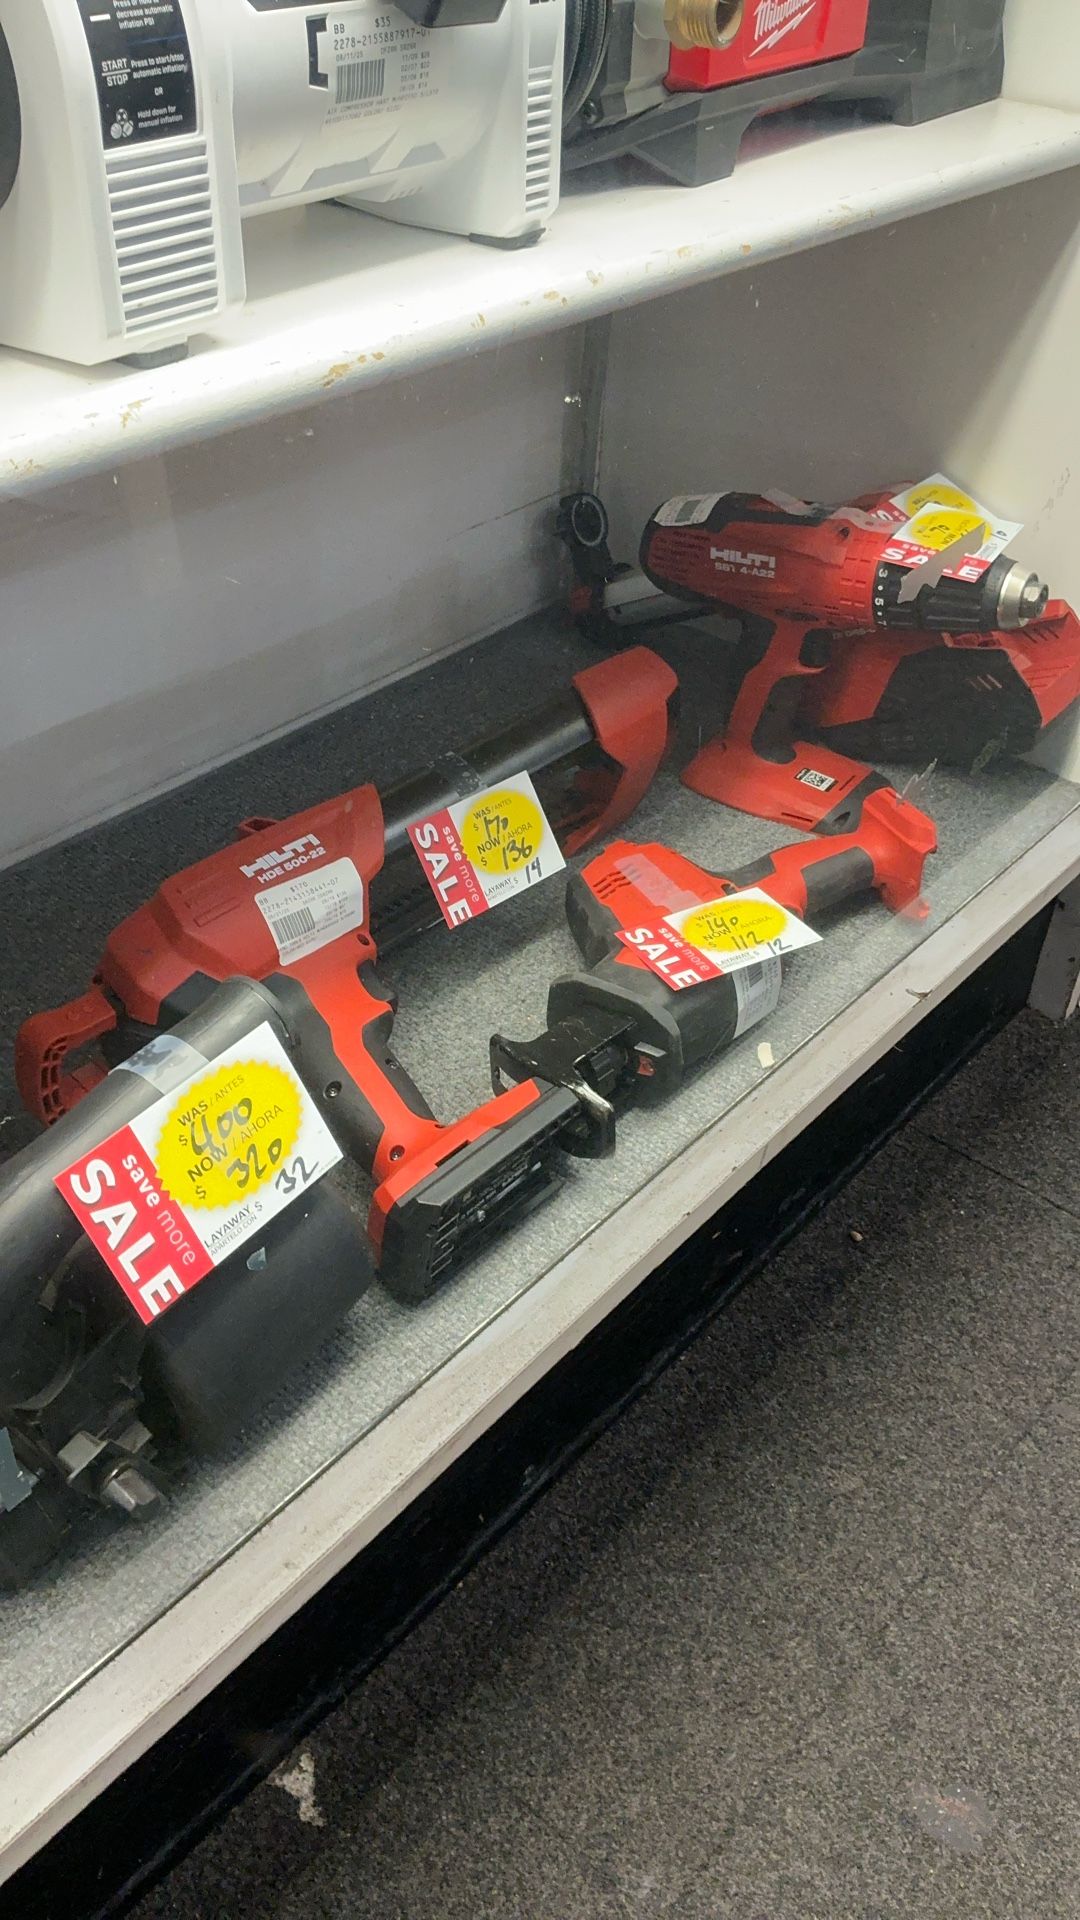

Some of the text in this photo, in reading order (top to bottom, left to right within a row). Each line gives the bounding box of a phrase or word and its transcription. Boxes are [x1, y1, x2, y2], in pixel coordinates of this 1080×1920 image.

[116, 4, 174, 19] decrease automatic
[119, 17, 155, 30] inflation PSI
[334, 16, 391, 34] BB $35
[101, 58, 128, 72] START
[130, 53, 184, 68] Press to start/stop
[106, 74, 128, 87] STOP
[133, 64, 186, 79] automatic inflation
[154, 86, 164, 96] OR
[138, 105, 176, 118] Hold down for
[138, 114, 183, 128] manual inflation
[710, 546, 776, 568] HILTI
[901, 543, 937, 555] save
[740, 566, 776, 578] 4-A22
[880, 547, 984, 579] SAE
[874, 597, 884, 606] 5
[473, 806, 491, 820] WAS
[473, 814, 509, 840] $ 170
[476, 837, 501, 855] NOW
[507, 822, 533, 842] AHORA
[240, 833, 321, 878] HILTI
[480, 837, 534, 870] $ 136
[257, 846, 327, 884] HDE 500-22
[415, 822, 473, 926] SALE
[442, 826, 480, 902] save more
[485, 875, 512, 897] LAYAWAY
[525, 856, 542, 884] 14
[696, 911, 716, 922] WAS
[706, 916, 739, 934] 140
[702, 928, 732, 942] NOW
[731, 931, 764, 950] 112
[658, 927, 684, 948] save
[682, 948, 710, 972] more
[767, 938, 792, 956] 12
[624, 927, 704, 988] SALE
[177, 1100, 210, 1128] WAS
[214, 1074, 246, 1101] ANTES
[178, 1097, 253, 1156] $ 400
[186, 1143, 229, 1182] NOW
[239, 1104, 284, 1146] AHORA
[194, 1184, 208, 1200] $
[226, 1137, 283, 1189] 320
[122, 1153, 197, 1266] save more
[204, 1204, 251, 1248] LAYAWAY
[254, 1201, 263, 1212] $
[275, 1156, 320, 1194] 32
[70, 1158, 187, 1316] SALE
